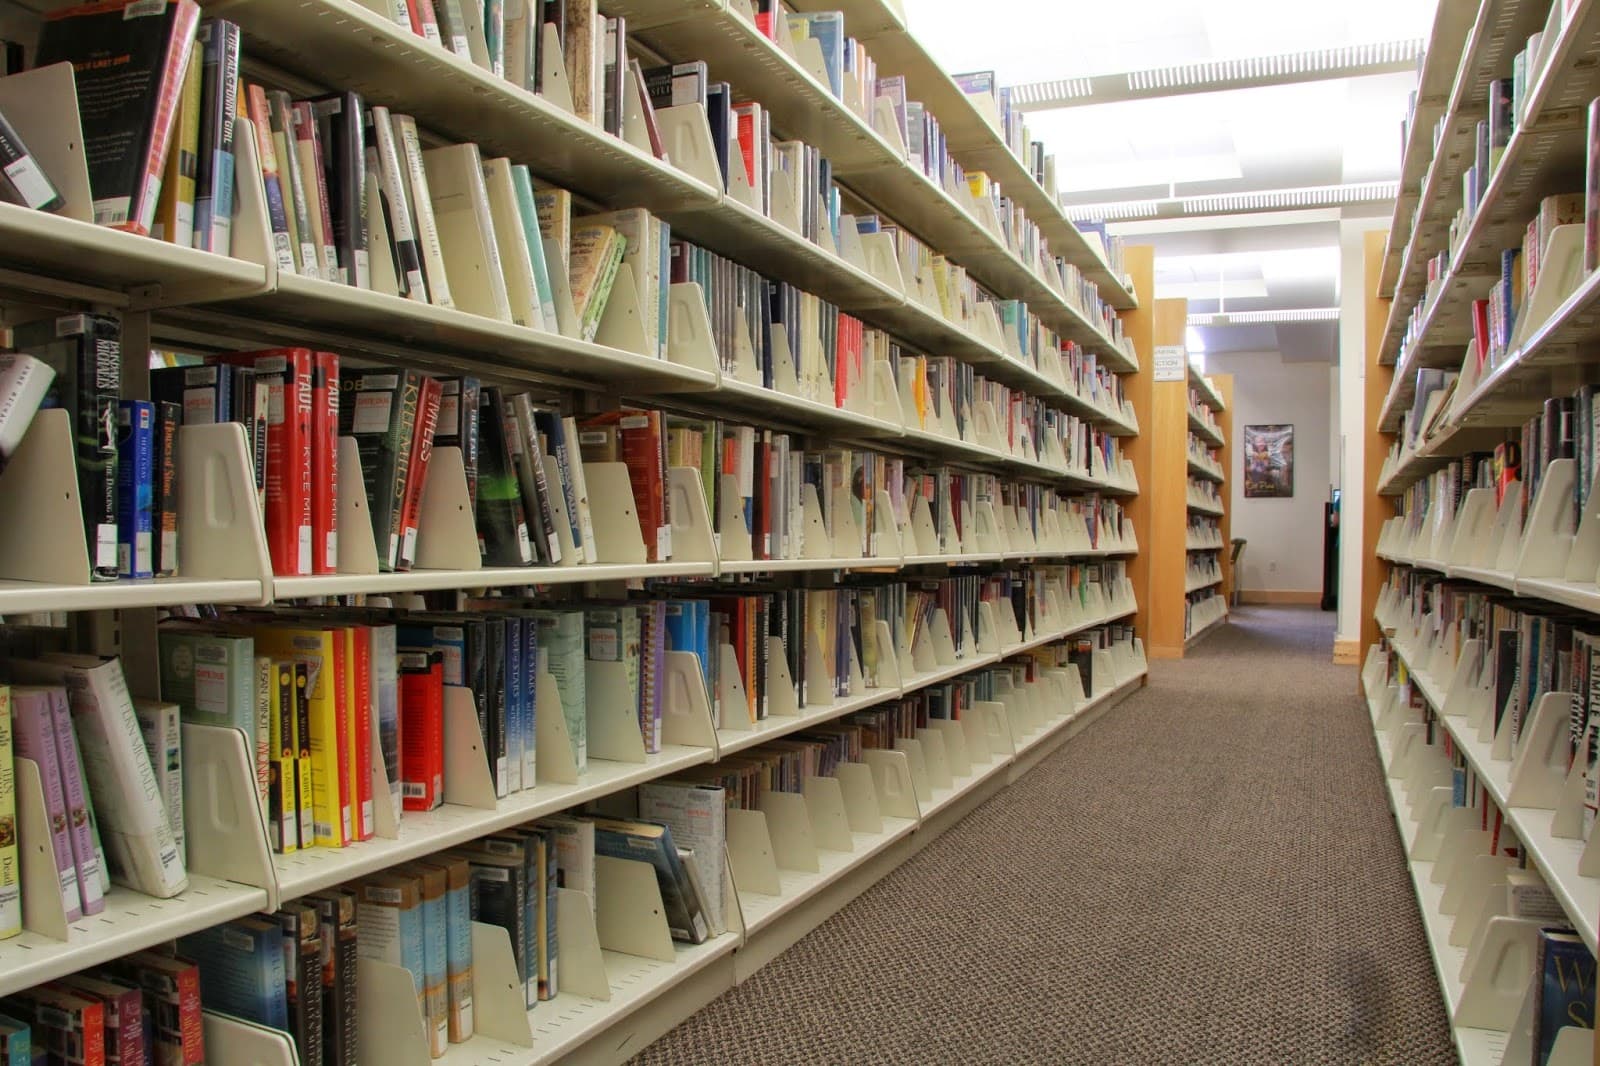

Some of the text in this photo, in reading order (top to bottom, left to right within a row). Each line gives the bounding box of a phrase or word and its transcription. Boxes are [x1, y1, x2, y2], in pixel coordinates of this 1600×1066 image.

[226, 31, 237, 51] THE
[222, 120, 234, 143] GIRL
[96, 338, 110, 388] MICHAELS
[109, 341, 120, 388] BARBARA
[327, 378, 339, 417] FADE
[298, 373, 311, 526] FADE KYLE MIL
[395, 383, 417, 498] KYLE MILLS
[418, 401, 439, 462] MILLS
[105, 460, 113, 476] THE
[255, 424, 265, 486] Millhauser
[511, 623, 519, 651] CAGE
[260, 663, 268, 694] SUSAN
[512, 663, 520, 697] STARS
[1590, 664, 1600, 716] SIMPLE
[260, 698, 268, 729] MINOT
[1568, 692, 1581, 743] RUINS
[119, 702, 156, 801] FERN MICHAELS
[2, 857, 13, 886] Deadl
